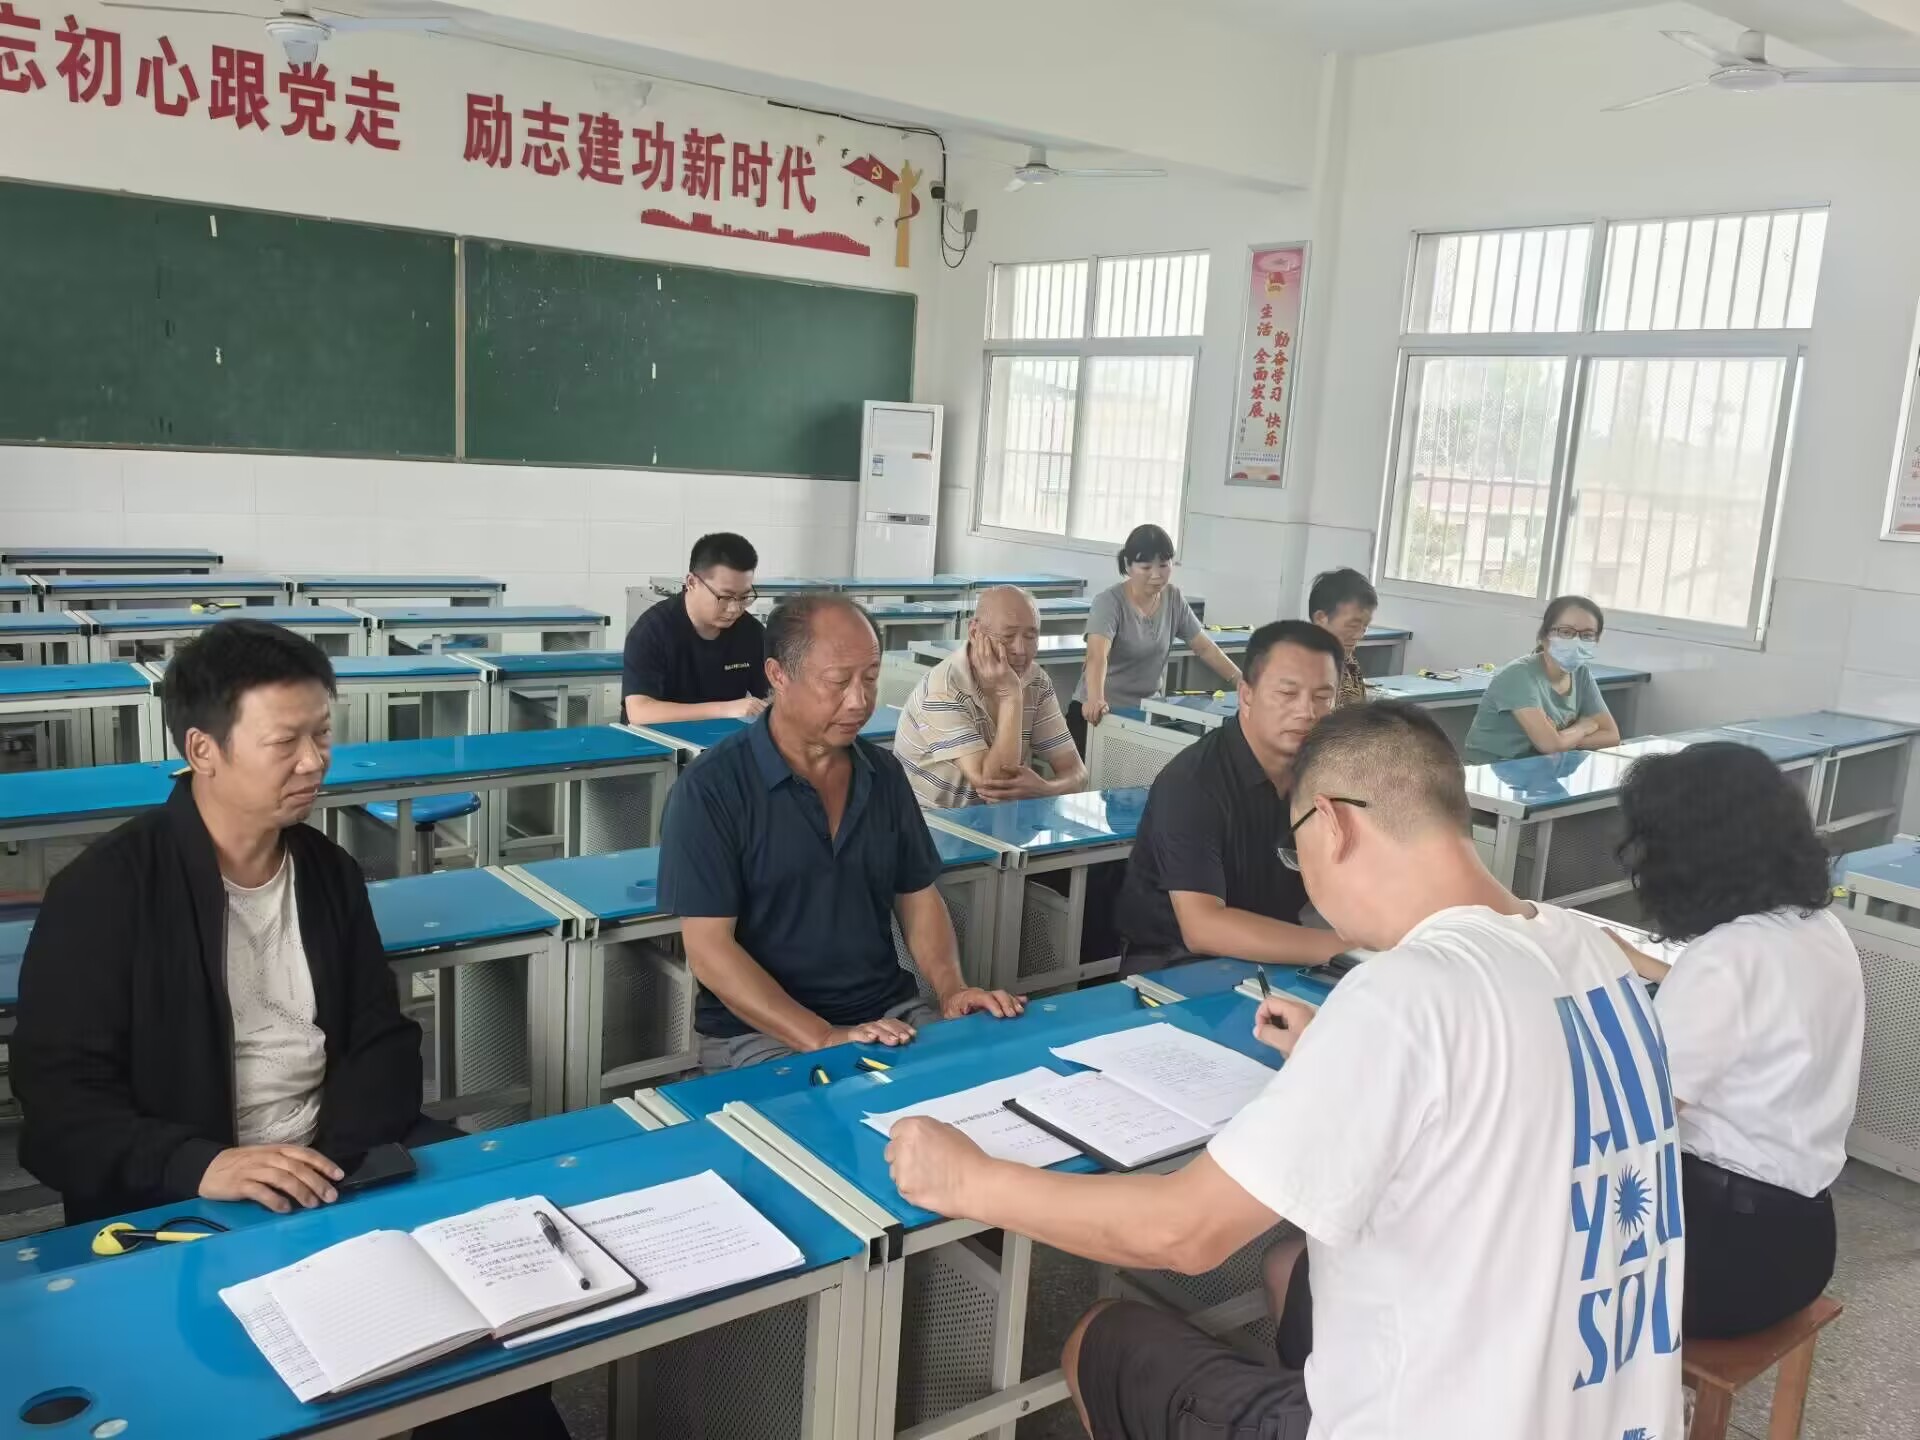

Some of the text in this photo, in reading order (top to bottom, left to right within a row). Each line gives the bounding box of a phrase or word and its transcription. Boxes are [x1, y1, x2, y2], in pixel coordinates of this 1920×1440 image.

[0, 2, 816, 213] 忘初心跟党走 励志建功新时代
[1248, 303, 1273, 417] 生活 全面发展
